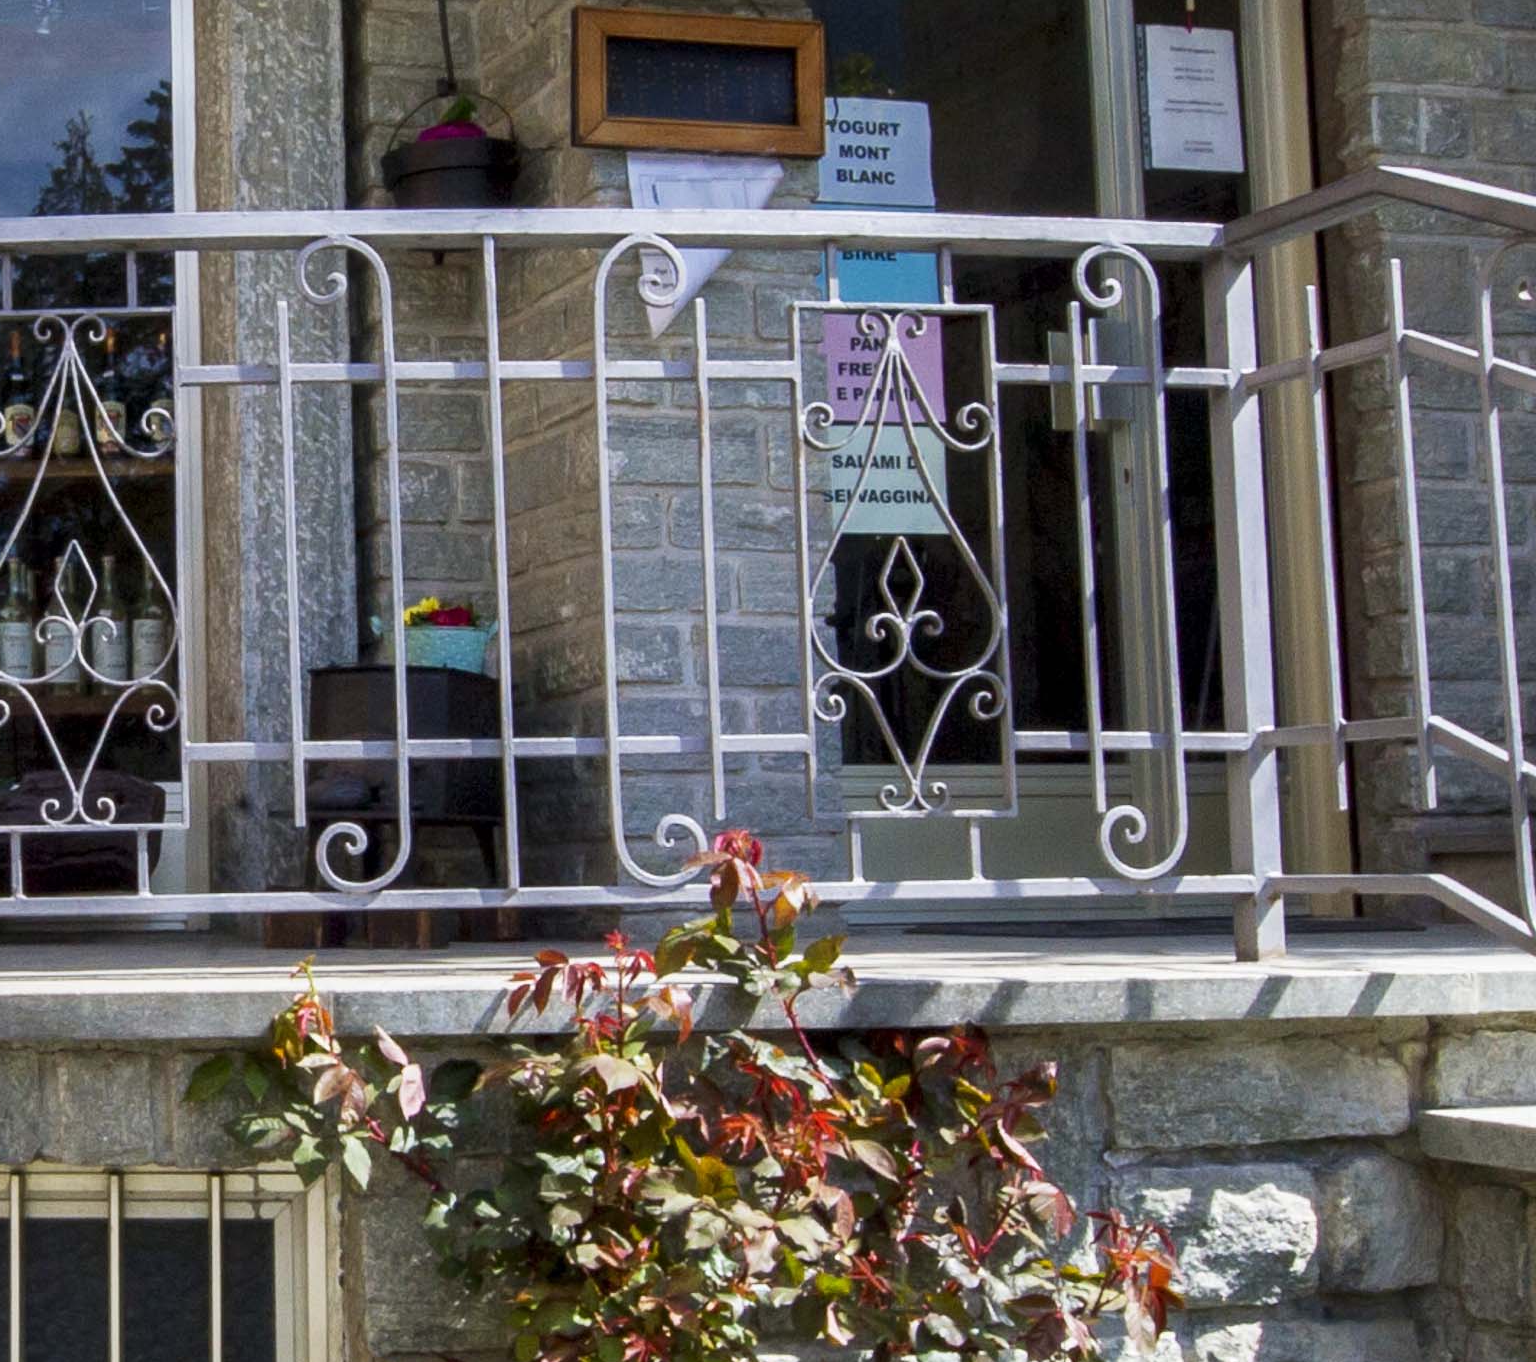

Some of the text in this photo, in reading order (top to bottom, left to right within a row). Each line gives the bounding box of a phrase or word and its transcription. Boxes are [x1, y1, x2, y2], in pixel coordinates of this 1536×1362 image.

[828, 120, 901, 137] YOGURT
[839, 144, 891, 161] MONT
[836, 168, 896, 186] BLANC
[850, 337, 886, 352] PAN
[836, 386, 848, 401] E
[832, 454, 901, 470] SALAMI
